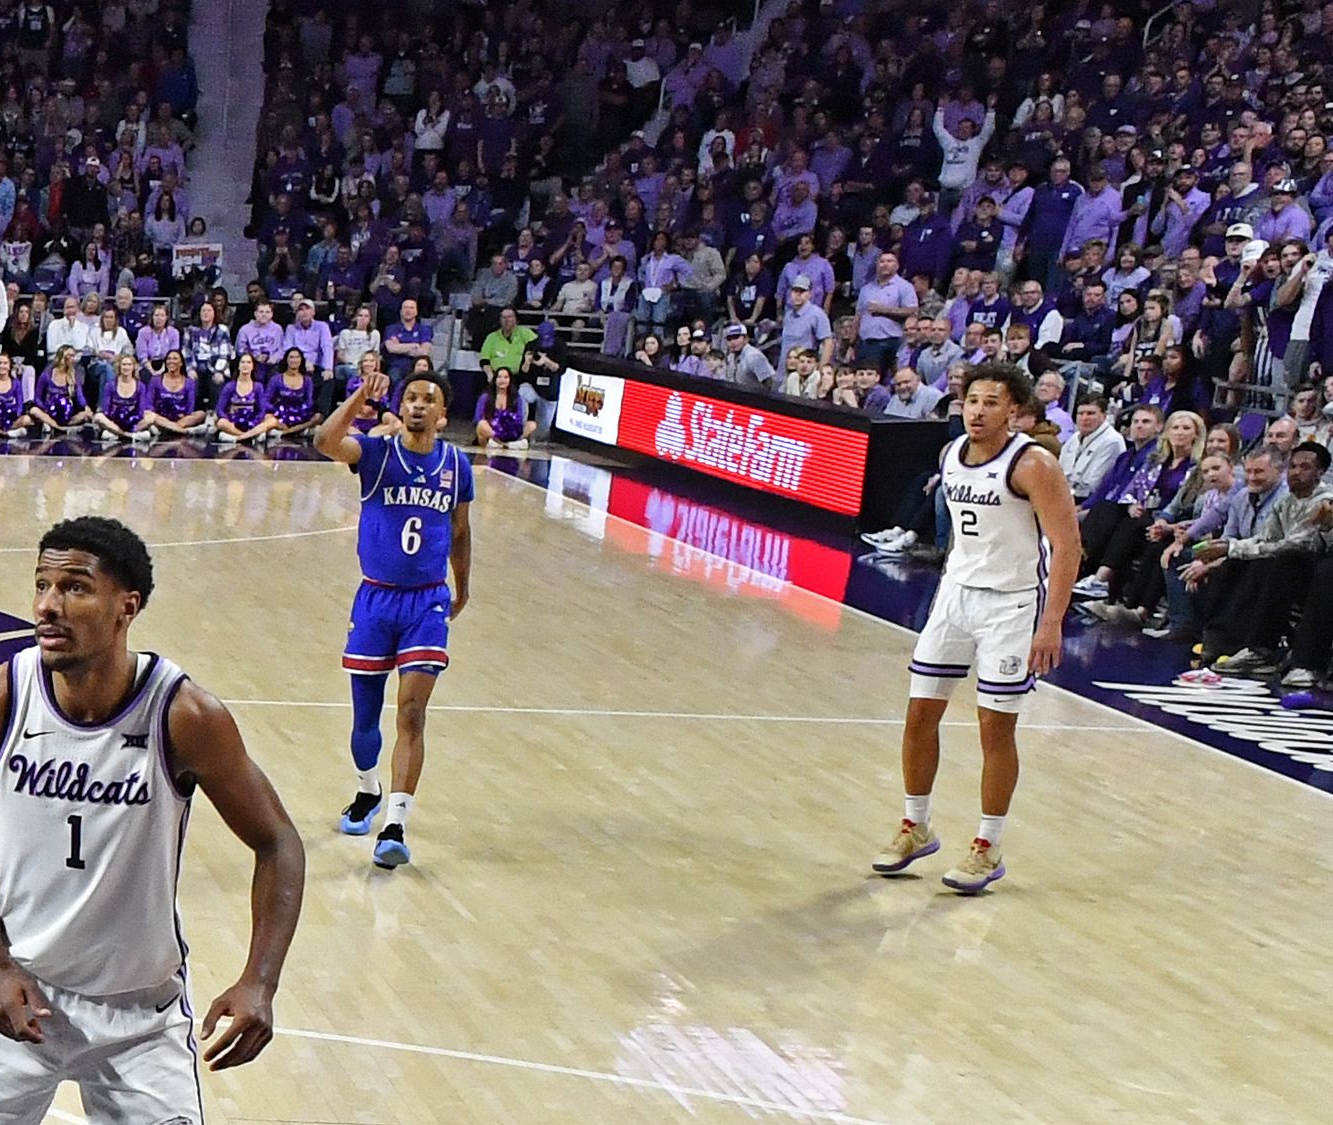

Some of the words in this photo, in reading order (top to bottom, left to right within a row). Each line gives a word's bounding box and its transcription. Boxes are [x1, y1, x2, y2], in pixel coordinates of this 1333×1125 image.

[383, 486, 451, 513] KANSAS
[944, 481, 1002, 506] Wildcats
[401, 516, 423, 555] 6
[960, 509, 979, 536] 2
[9, 754, 152, 806] Wildcats
[65, 814, 86, 870] 1
